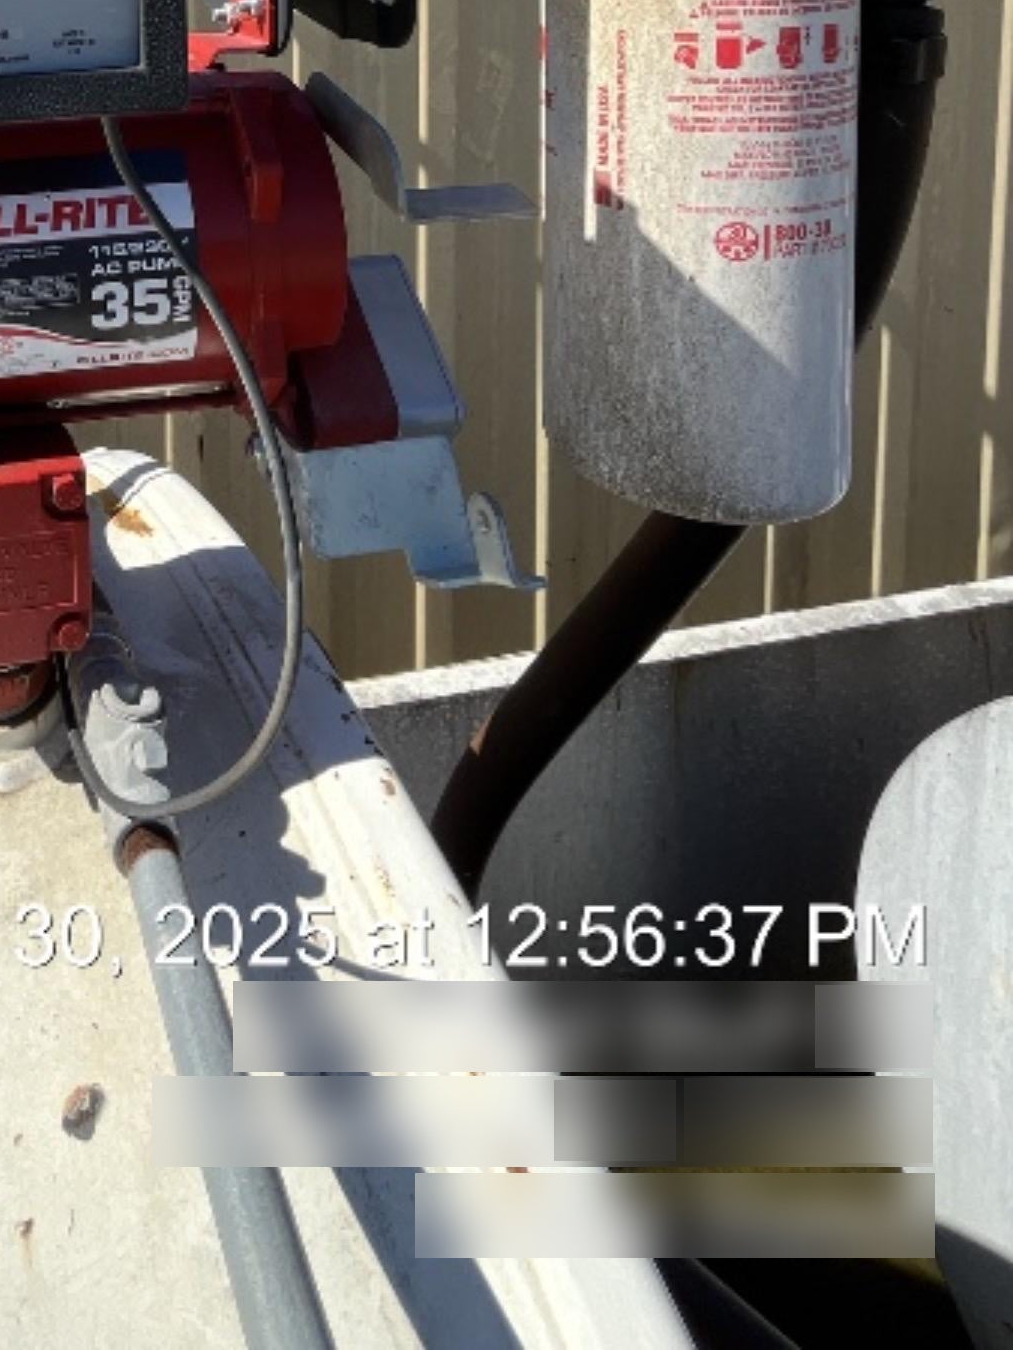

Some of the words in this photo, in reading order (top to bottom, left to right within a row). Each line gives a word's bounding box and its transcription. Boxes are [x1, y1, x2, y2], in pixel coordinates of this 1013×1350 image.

[91, 260, 123, 277] AC
[127, 256, 182, 274] PUM
[91, 278, 171, 329] 35
